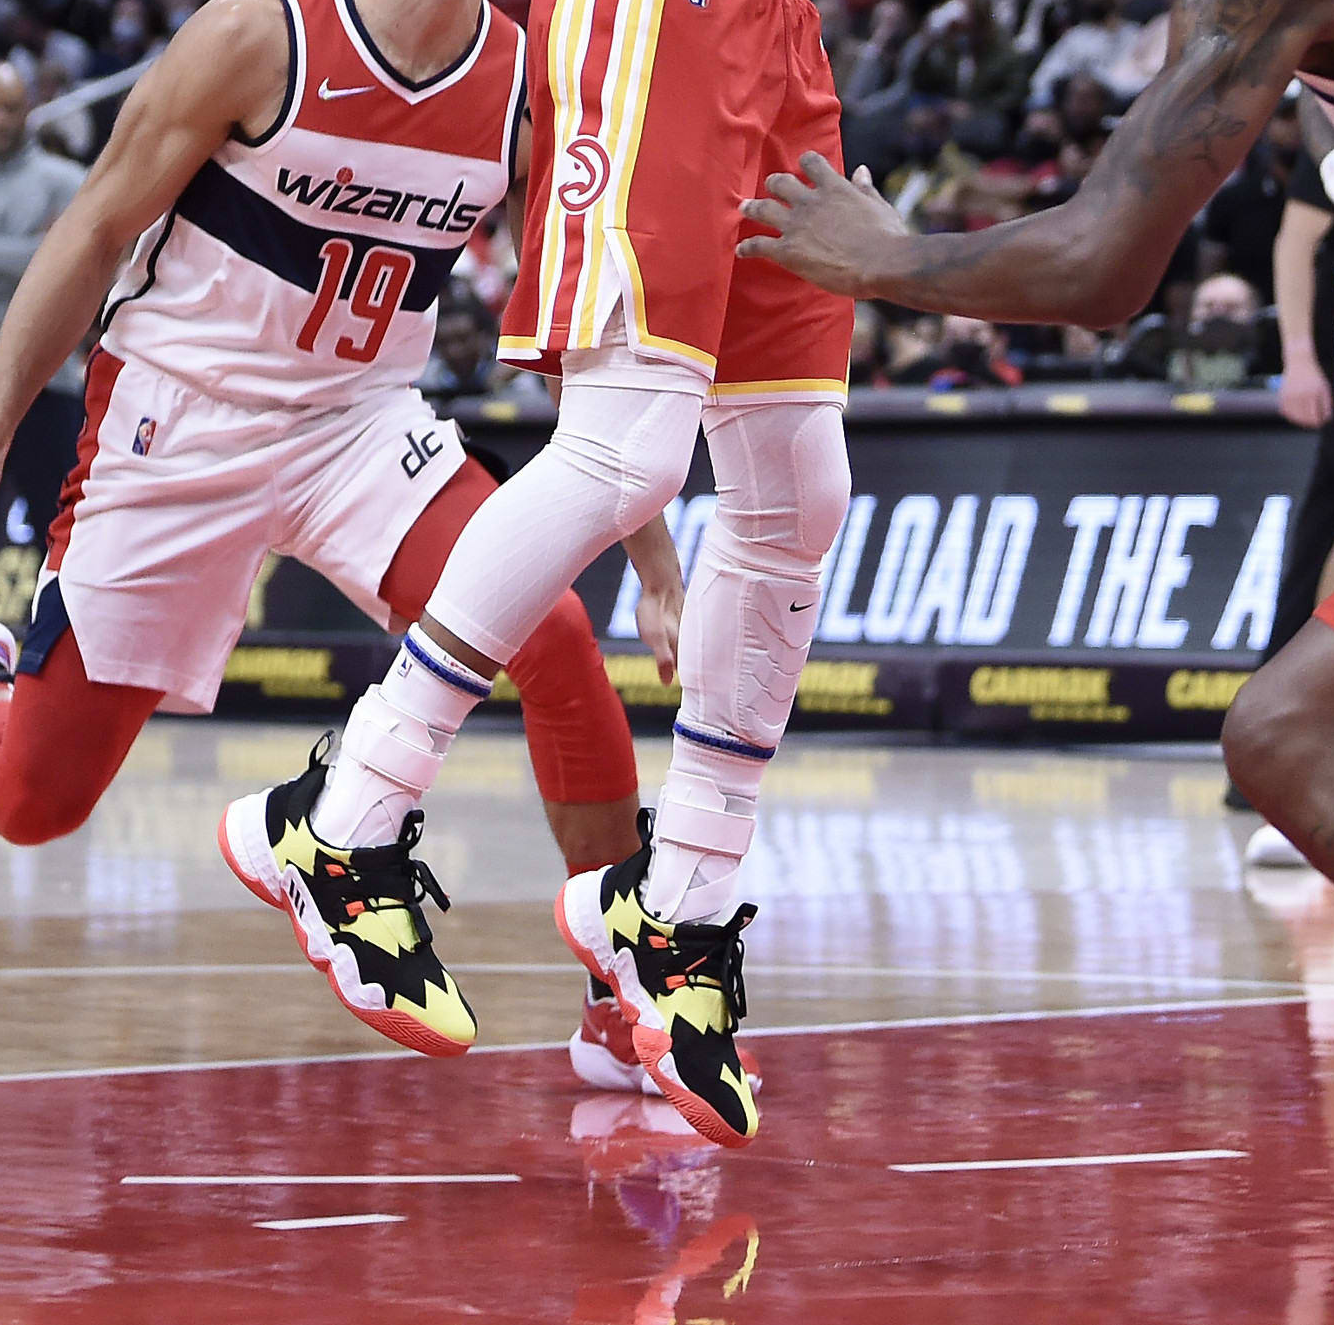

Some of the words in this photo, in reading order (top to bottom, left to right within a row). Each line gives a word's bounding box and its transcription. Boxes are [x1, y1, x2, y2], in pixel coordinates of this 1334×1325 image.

[277, 167, 487, 233] wizards
[295, 237, 416, 364] 19
[400, 430, 444, 480] dc
[1046, 494, 1219, 649] THE
